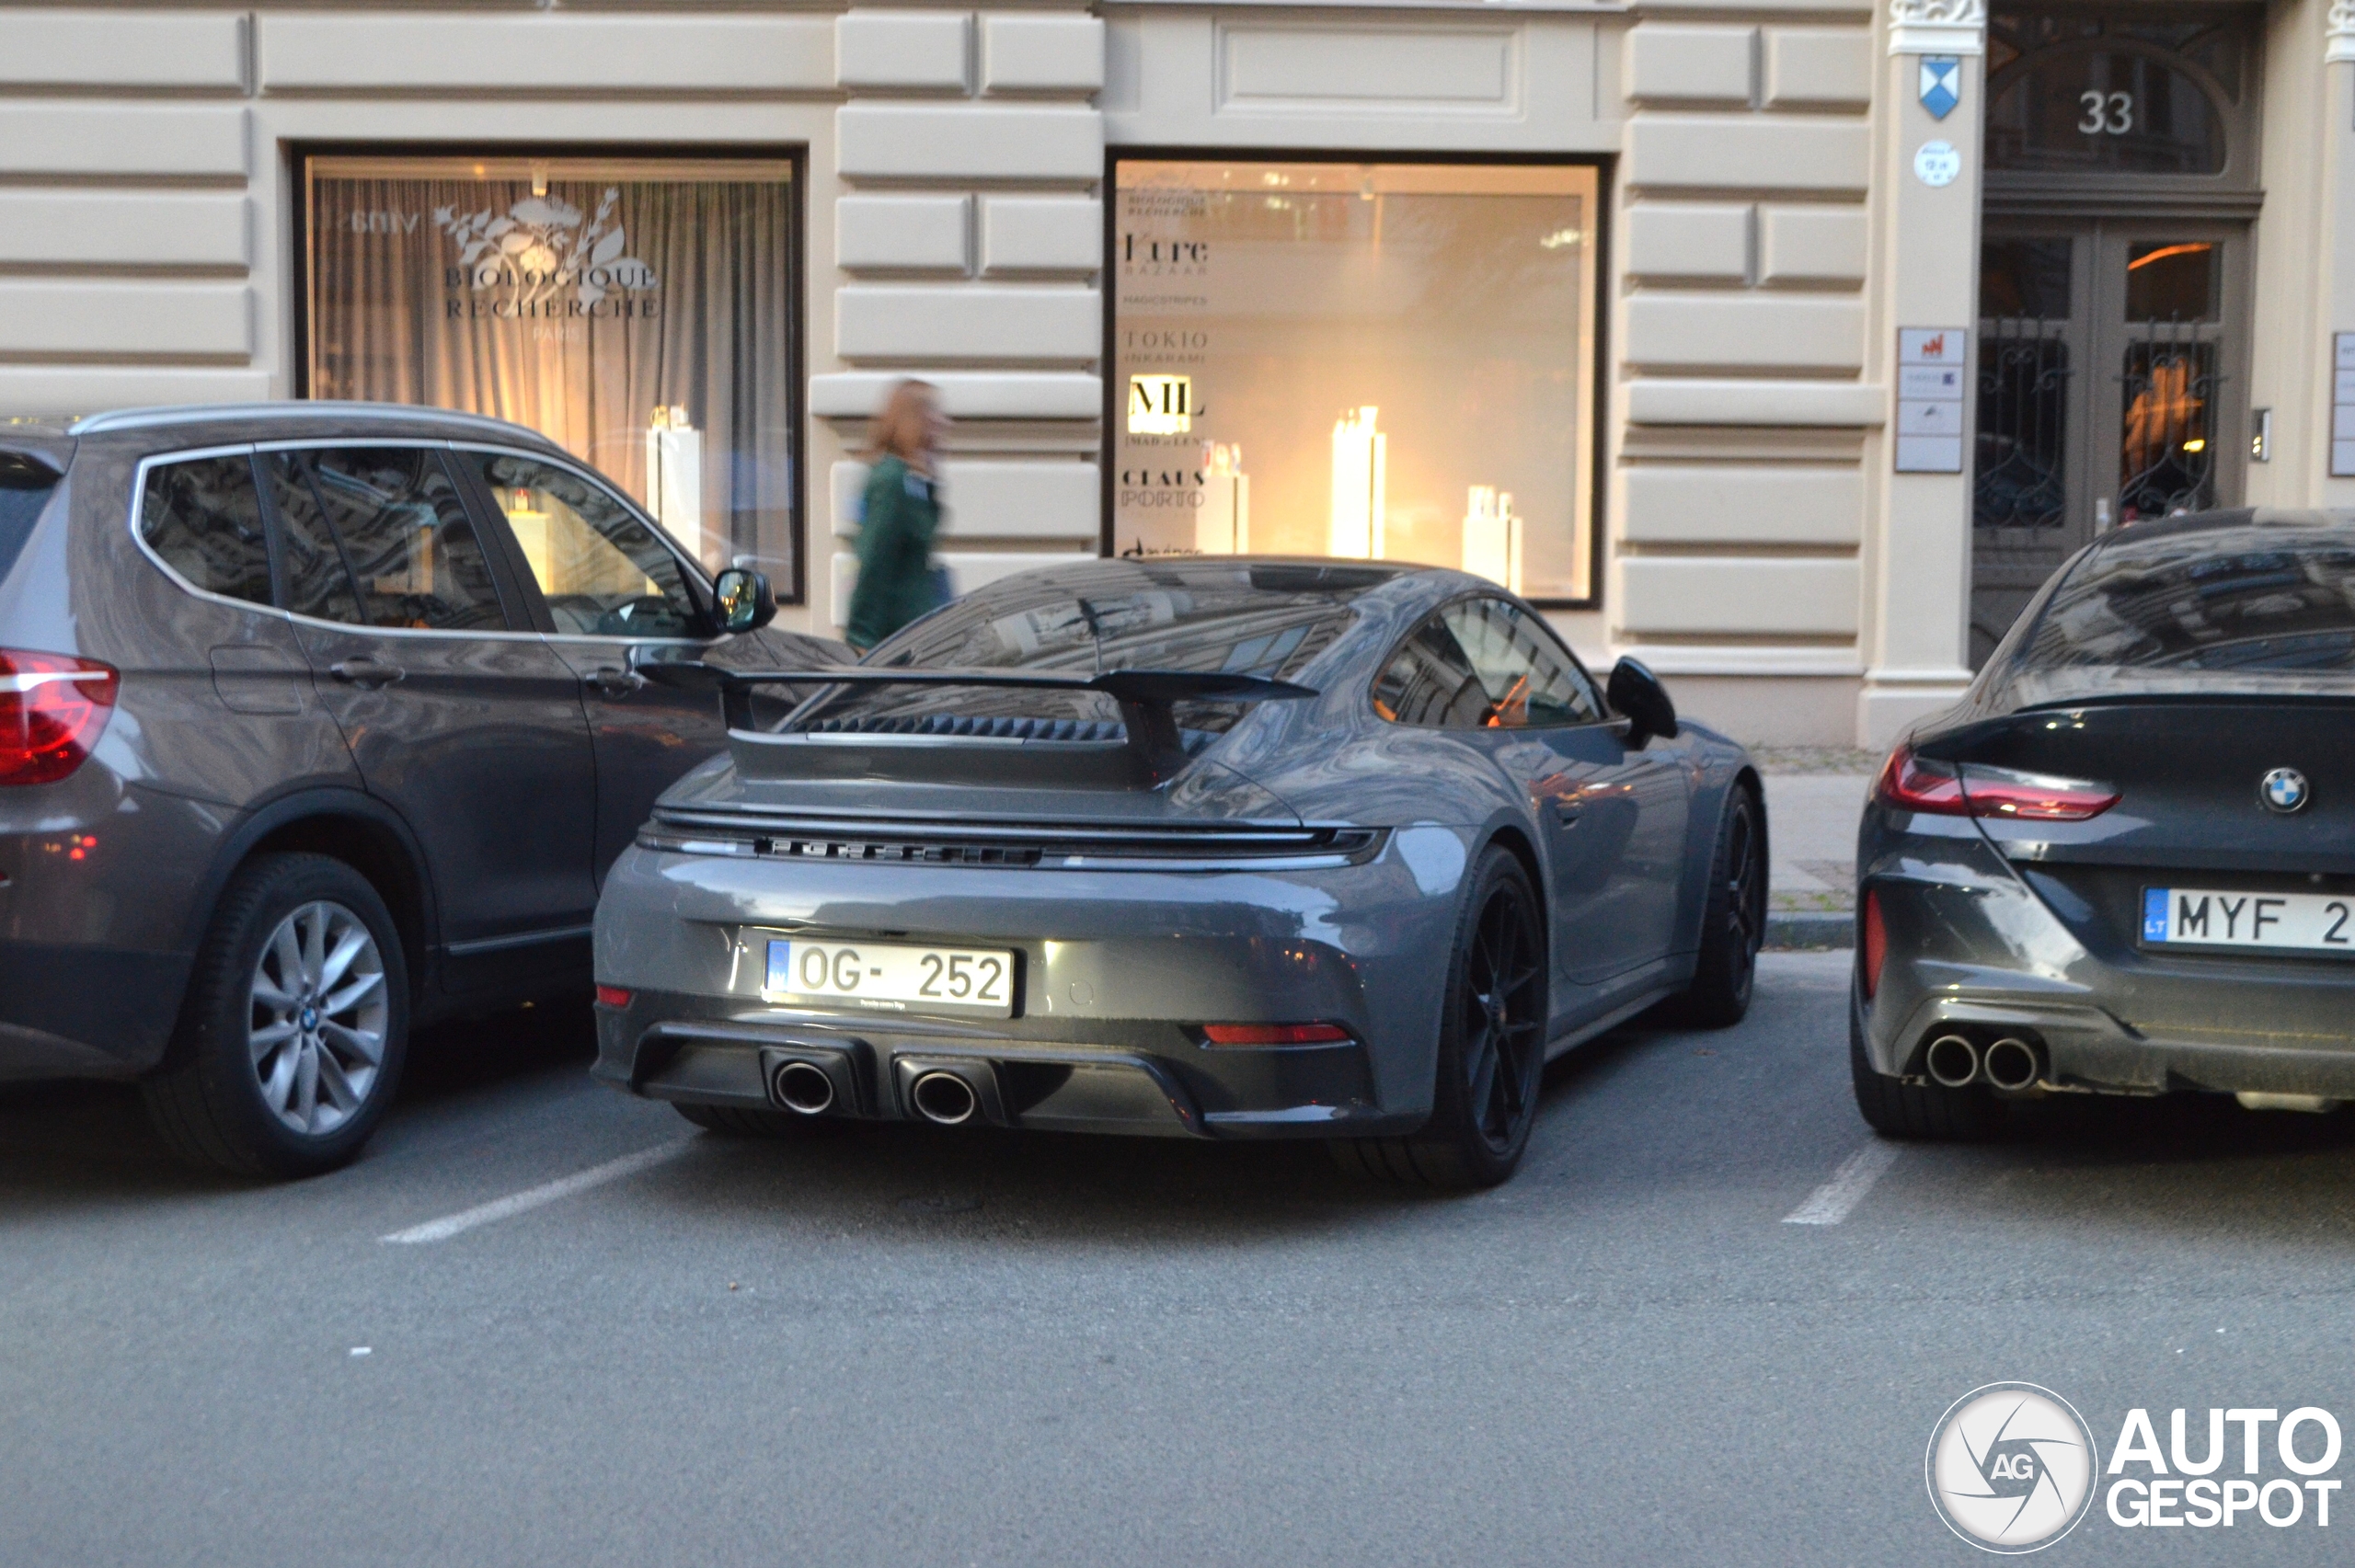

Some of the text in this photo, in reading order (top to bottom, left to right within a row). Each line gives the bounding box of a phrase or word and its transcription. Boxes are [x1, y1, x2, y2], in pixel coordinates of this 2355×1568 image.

[2078, 90, 2132, 135] 33
[446, 268, 658, 294] BIOLOGIQUE
[447, 300, 659, 318] RECHERCHE
[1123, 331, 1208, 348] TOKIO
[1123, 470, 1204, 486] CLAUS
[1121, 490, 1205, 508] PORTO
[2144, 920, 2165, 934] LT
[2177, 895, 2350, 944] MYF 2
[918, 953, 1003, 1001] 252
